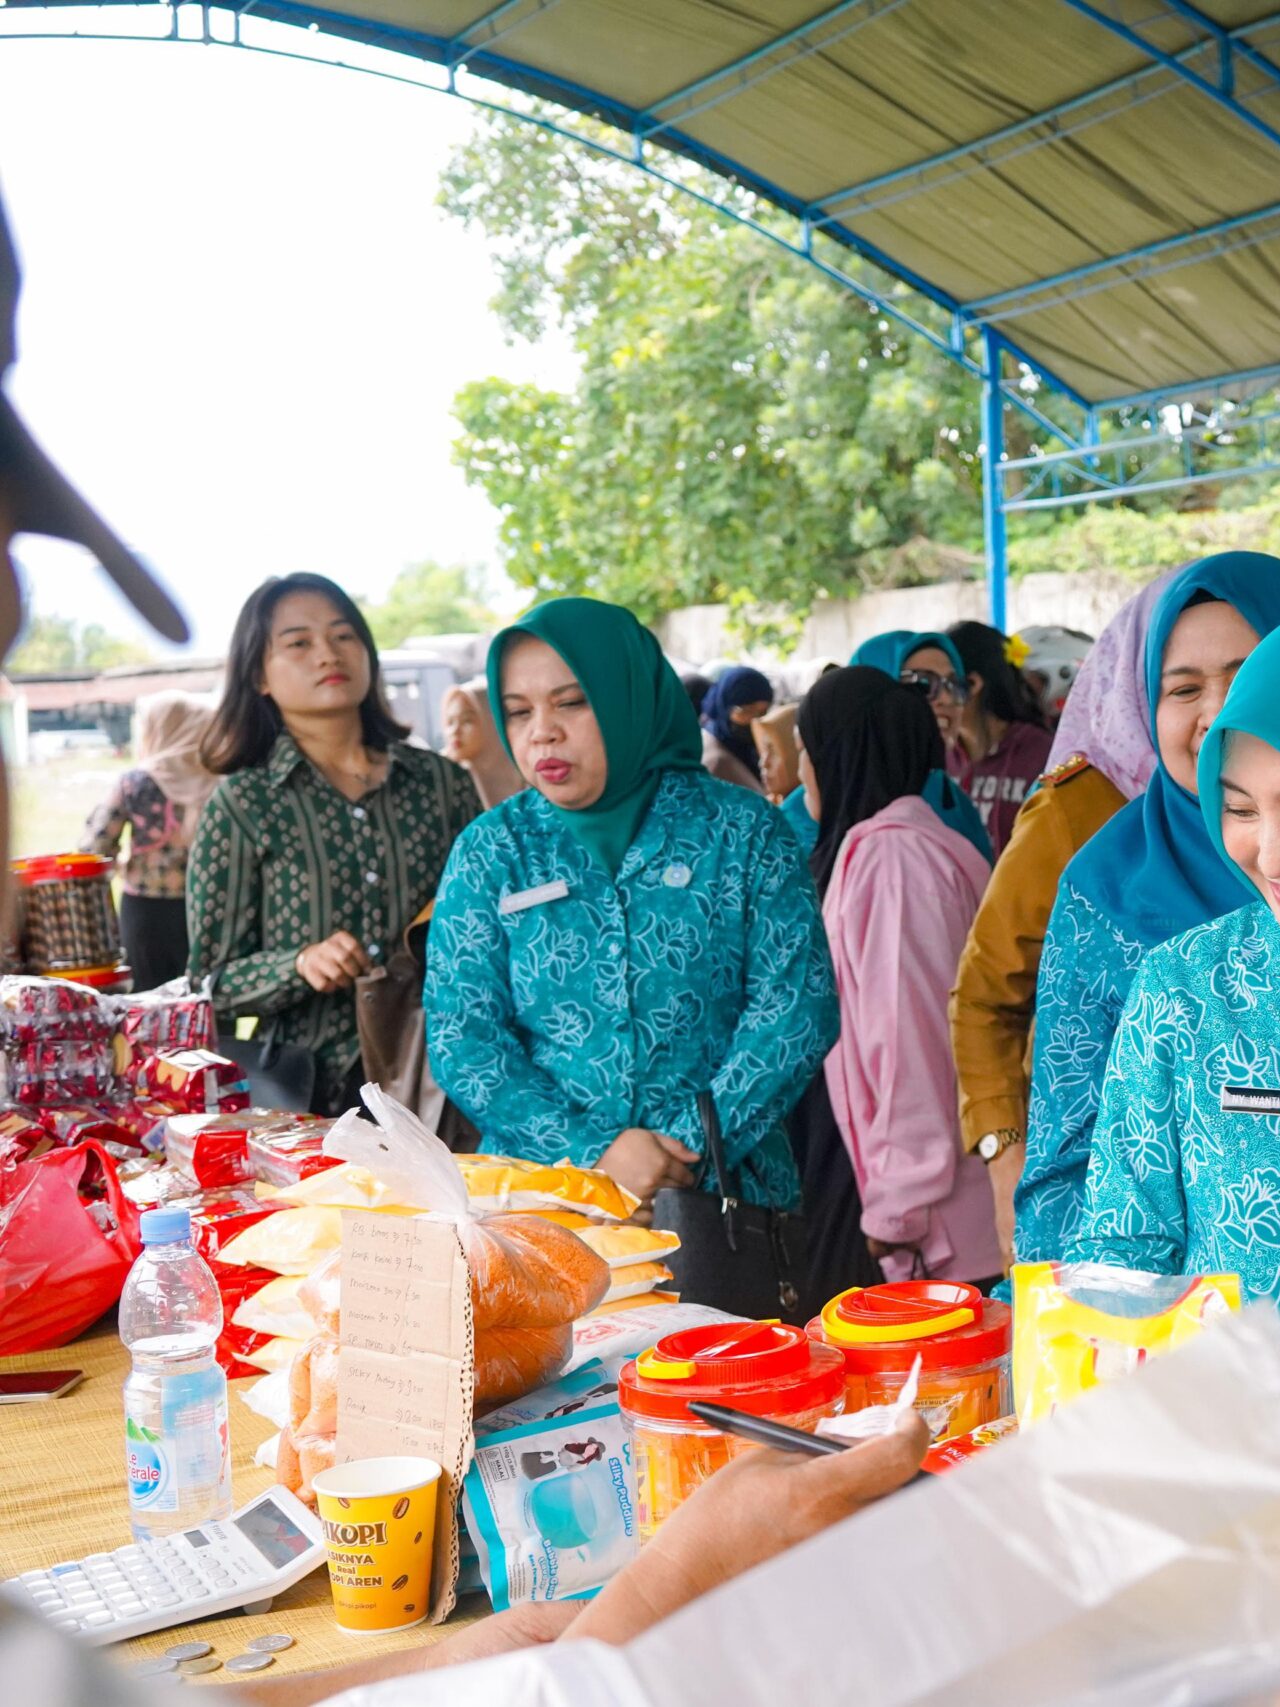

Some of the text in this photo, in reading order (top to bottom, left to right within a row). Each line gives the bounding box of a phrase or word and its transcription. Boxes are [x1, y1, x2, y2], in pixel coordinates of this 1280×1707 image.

[130, 1465, 160, 1480] erale
[609, 1457, 633, 1537] Silky Pudding
[322, 1521, 387, 1546] IKOPI
[347, 1577, 382, 1586] AREN
